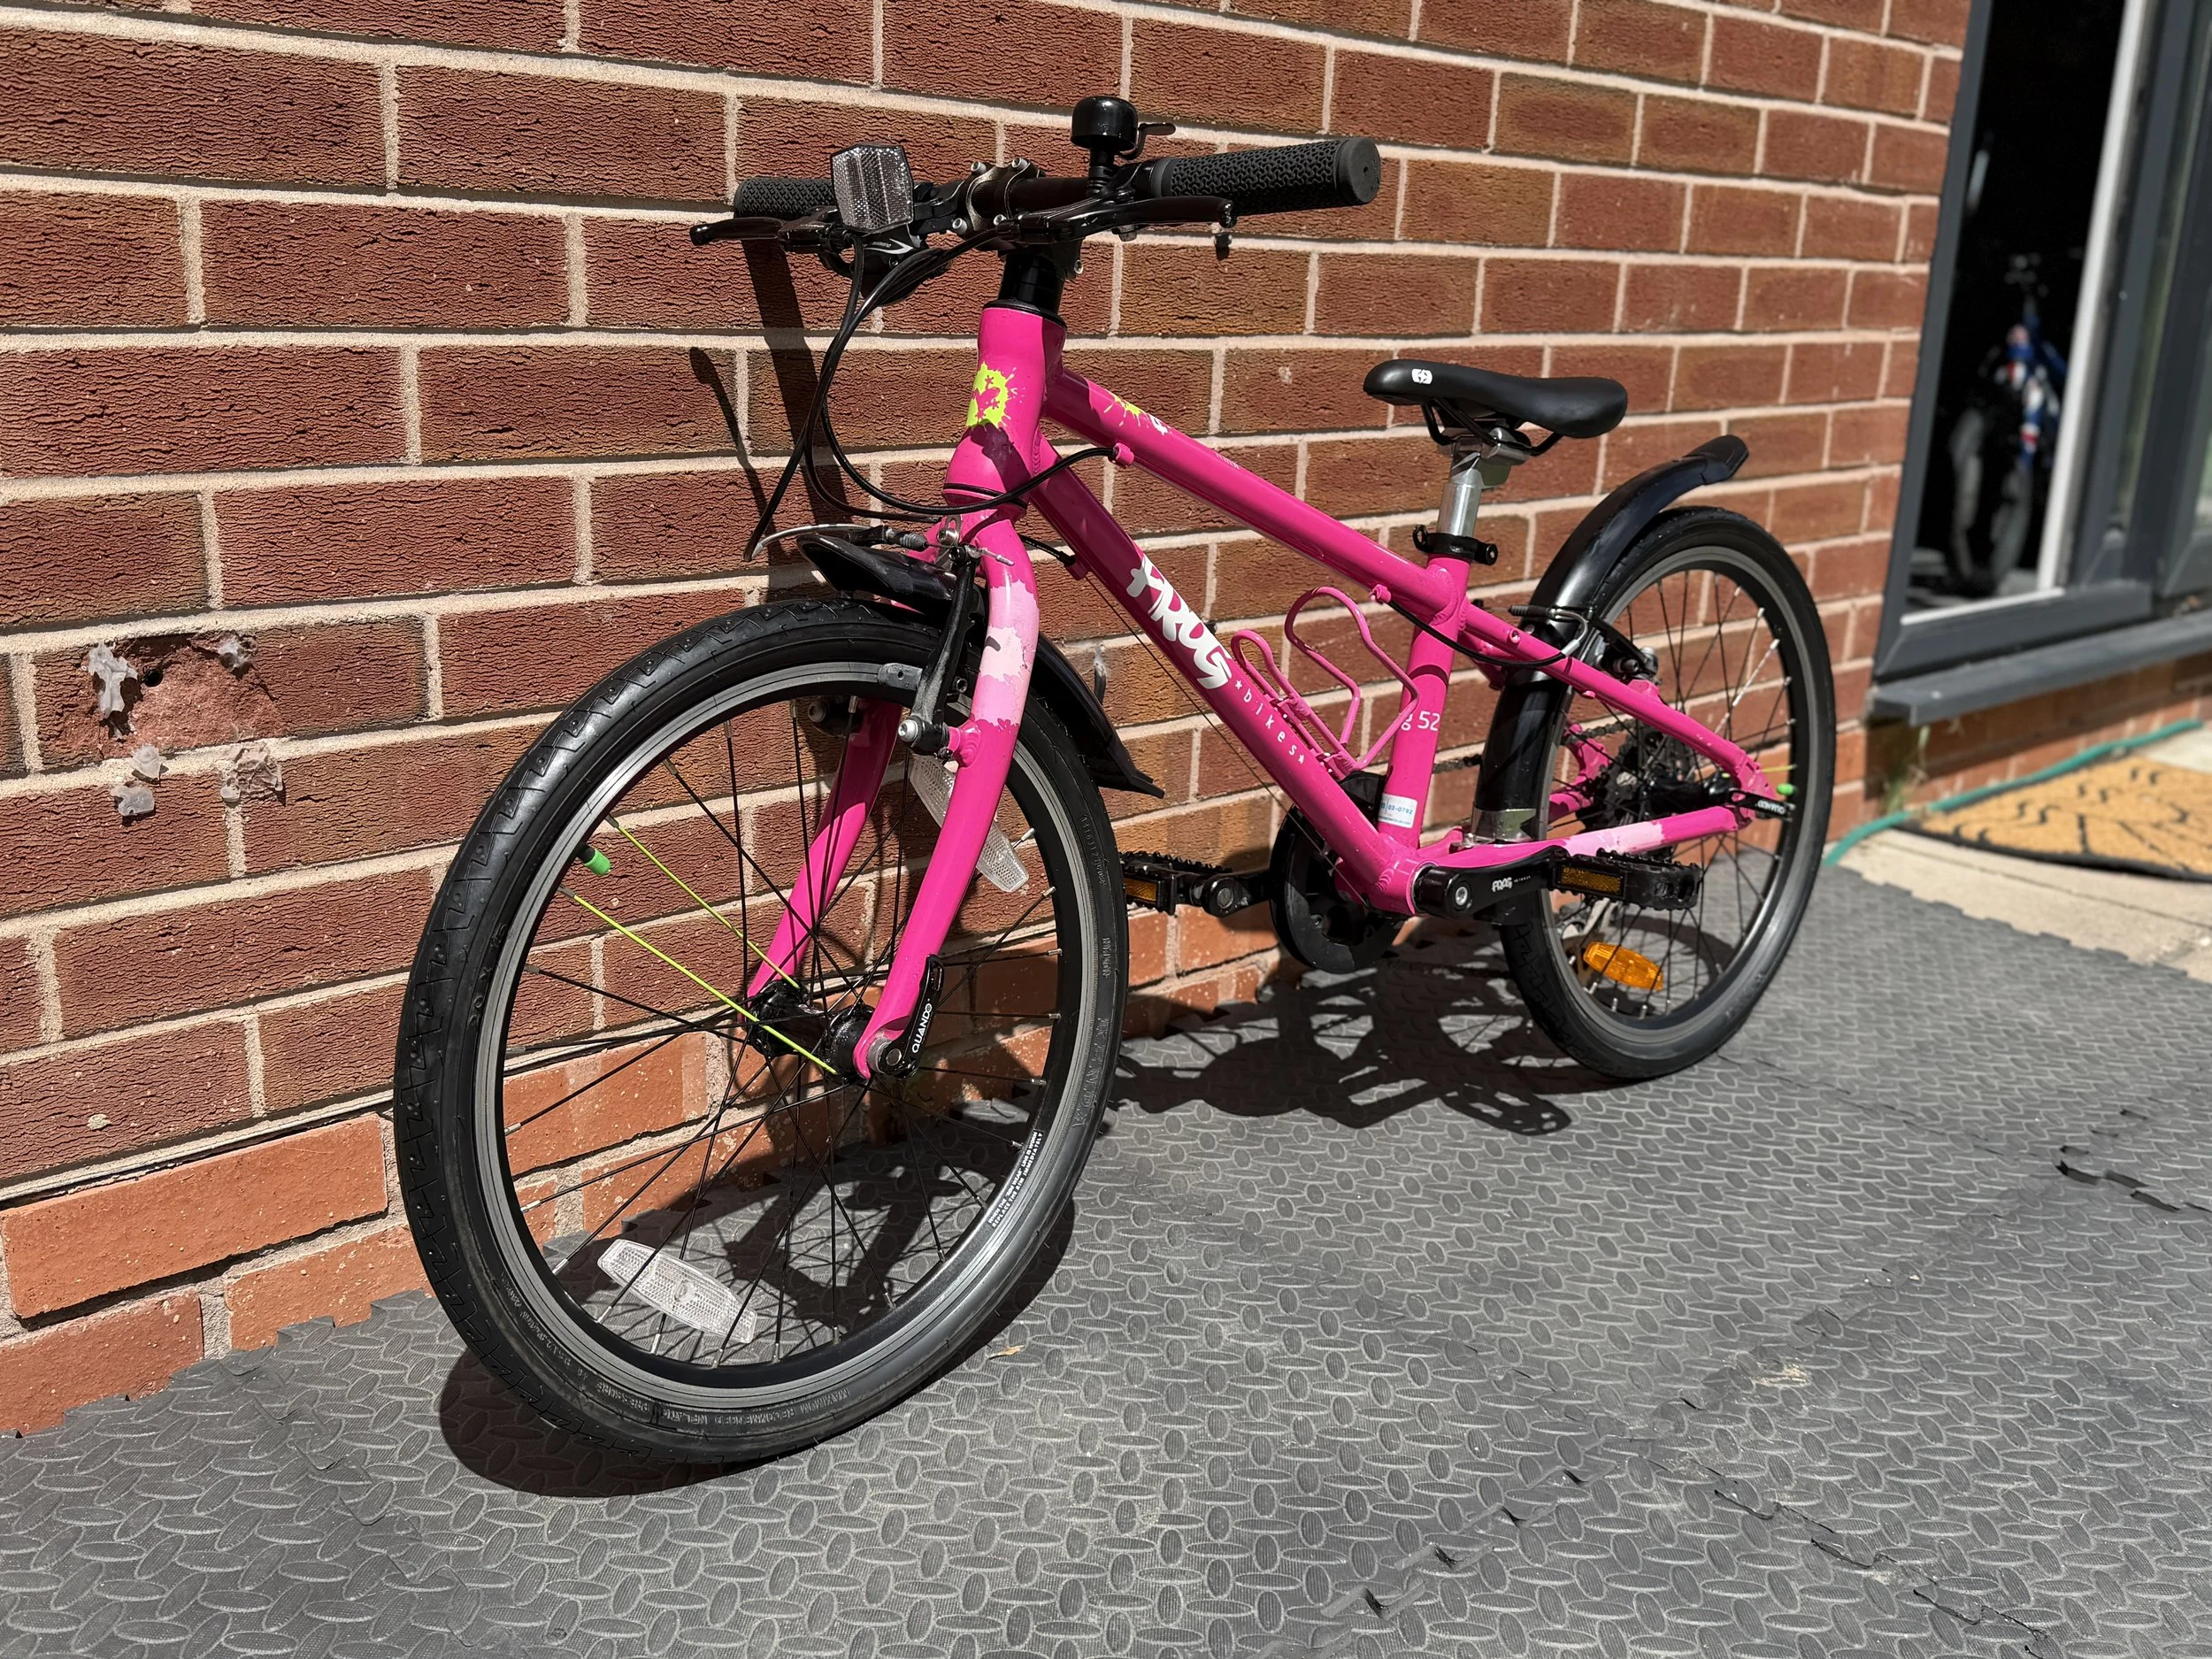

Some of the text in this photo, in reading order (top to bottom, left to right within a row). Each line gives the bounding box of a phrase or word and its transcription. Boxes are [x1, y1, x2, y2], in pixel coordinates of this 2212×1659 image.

[1243, 687, 1298, 756] bikes
[1417, 710, 1440, 732] 52
[912, 1002, 933, 1053] QUANDO
[993, 1203, 1010, 1227] REPLACE
